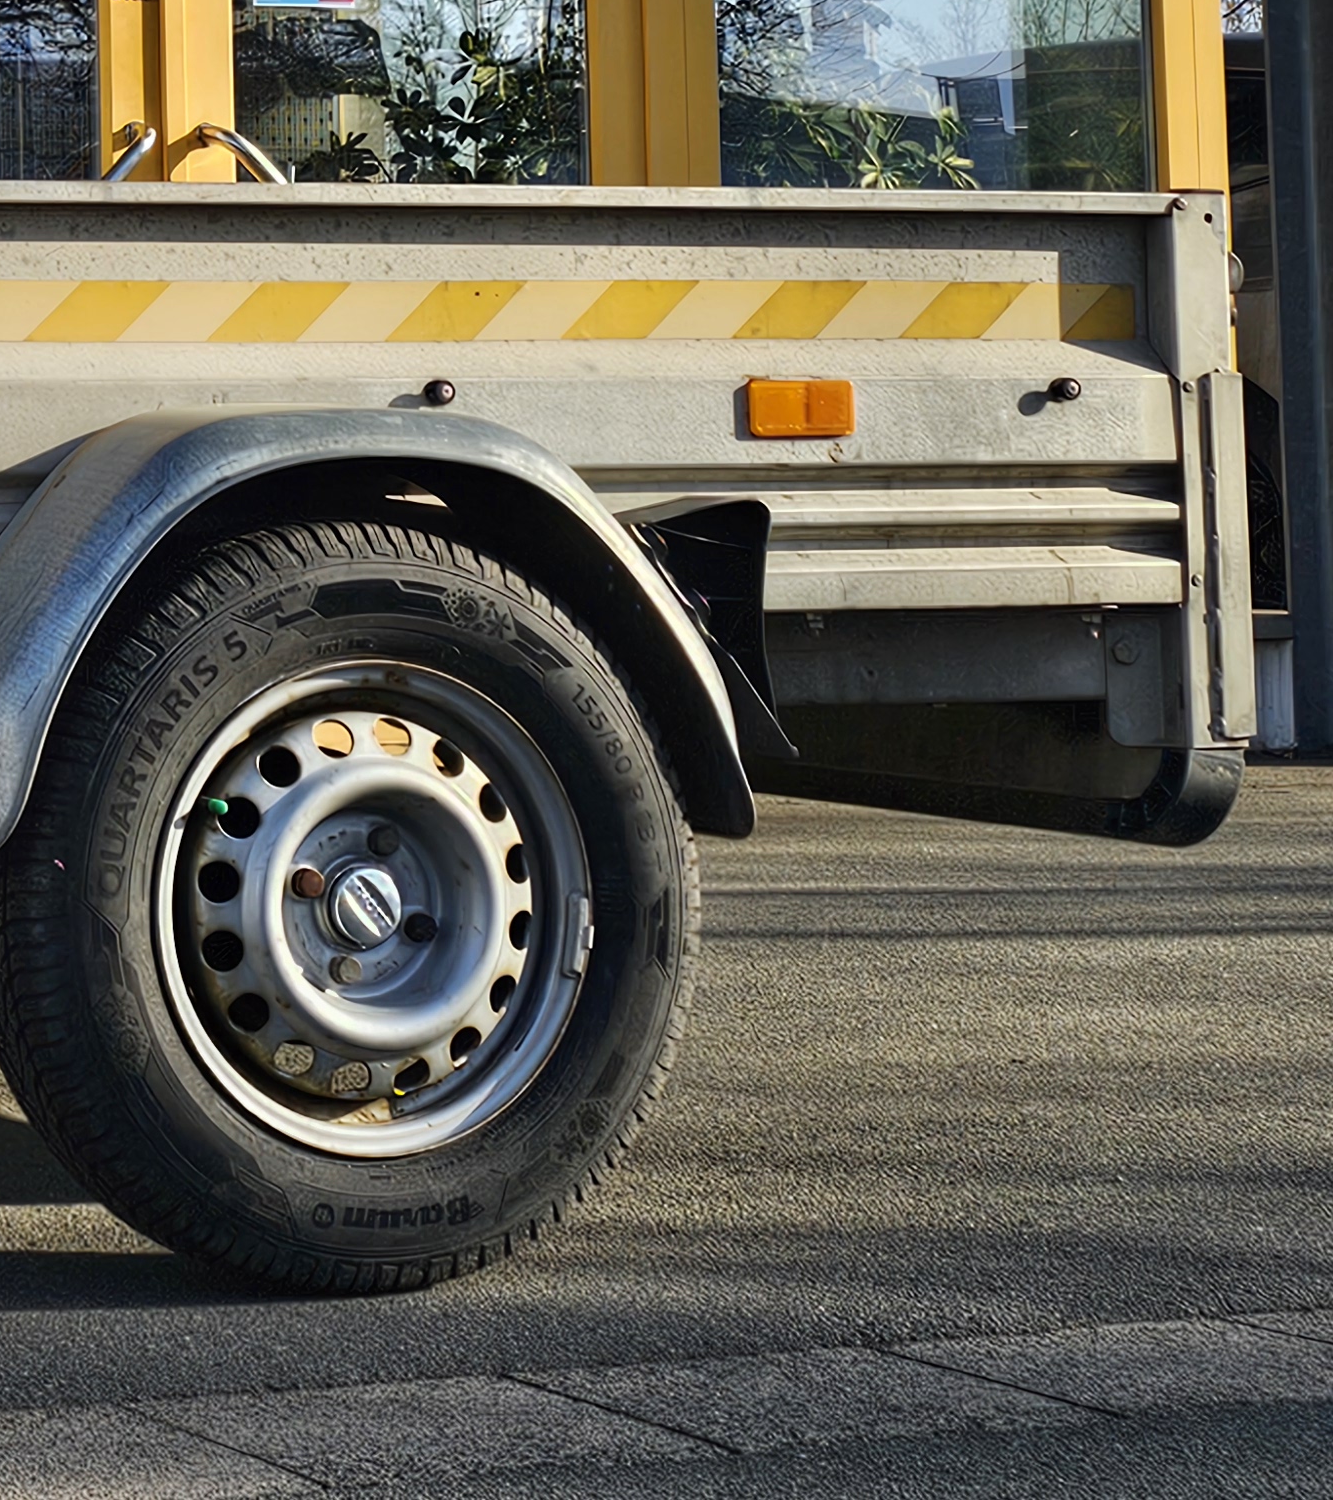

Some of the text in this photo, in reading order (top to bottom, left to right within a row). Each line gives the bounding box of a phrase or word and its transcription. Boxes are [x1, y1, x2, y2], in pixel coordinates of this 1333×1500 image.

[98, 630, 248, 896] QUARTARIS 5
[571, 683, 632, 775] 155/80
